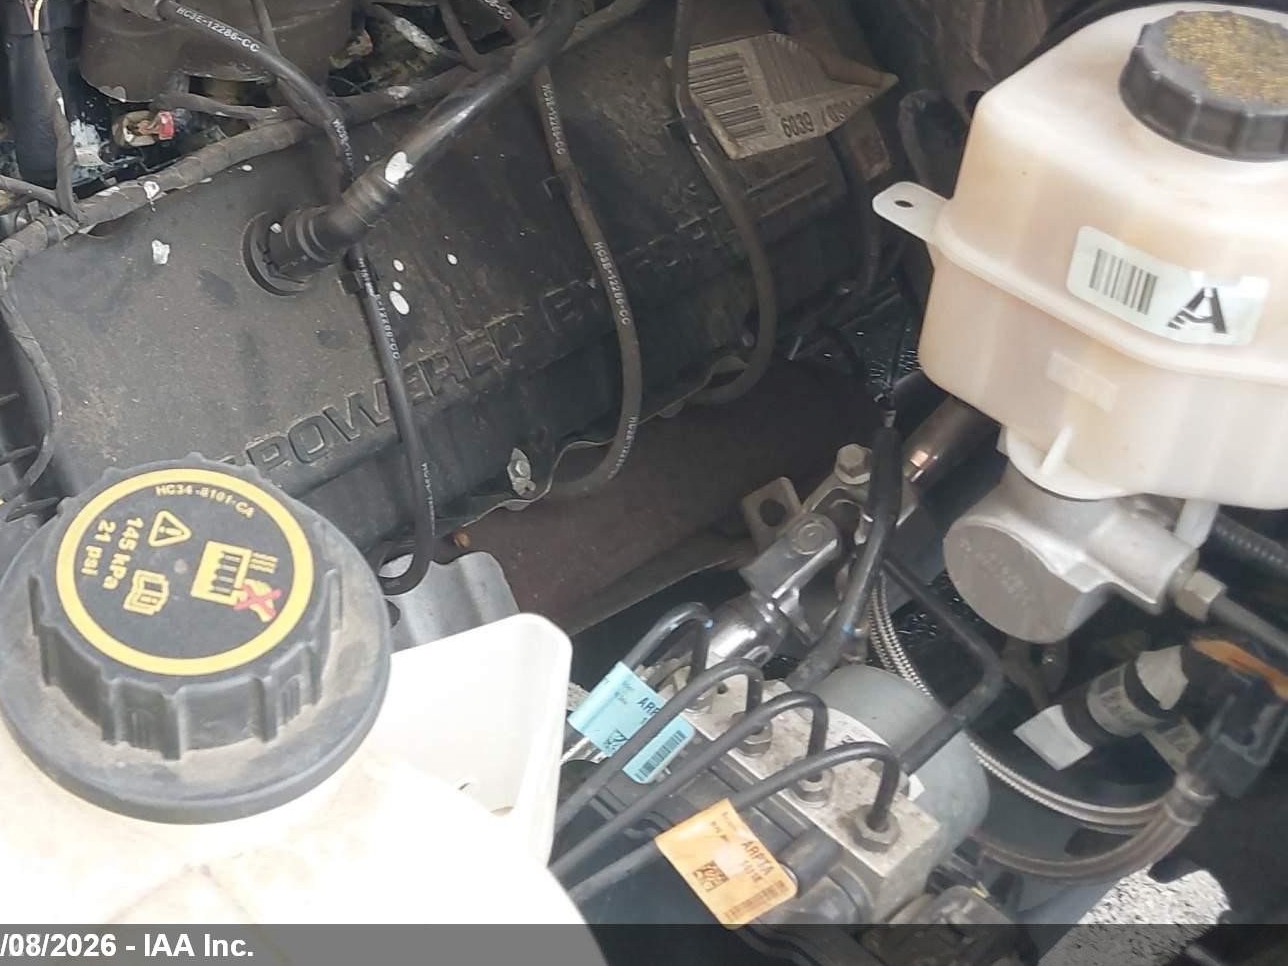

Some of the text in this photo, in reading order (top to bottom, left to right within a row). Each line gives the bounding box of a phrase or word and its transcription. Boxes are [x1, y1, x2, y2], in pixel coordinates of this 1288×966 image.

[80, 519, 118, 577] 21 psi
[101, 516, 145, 591] 145 kPa
